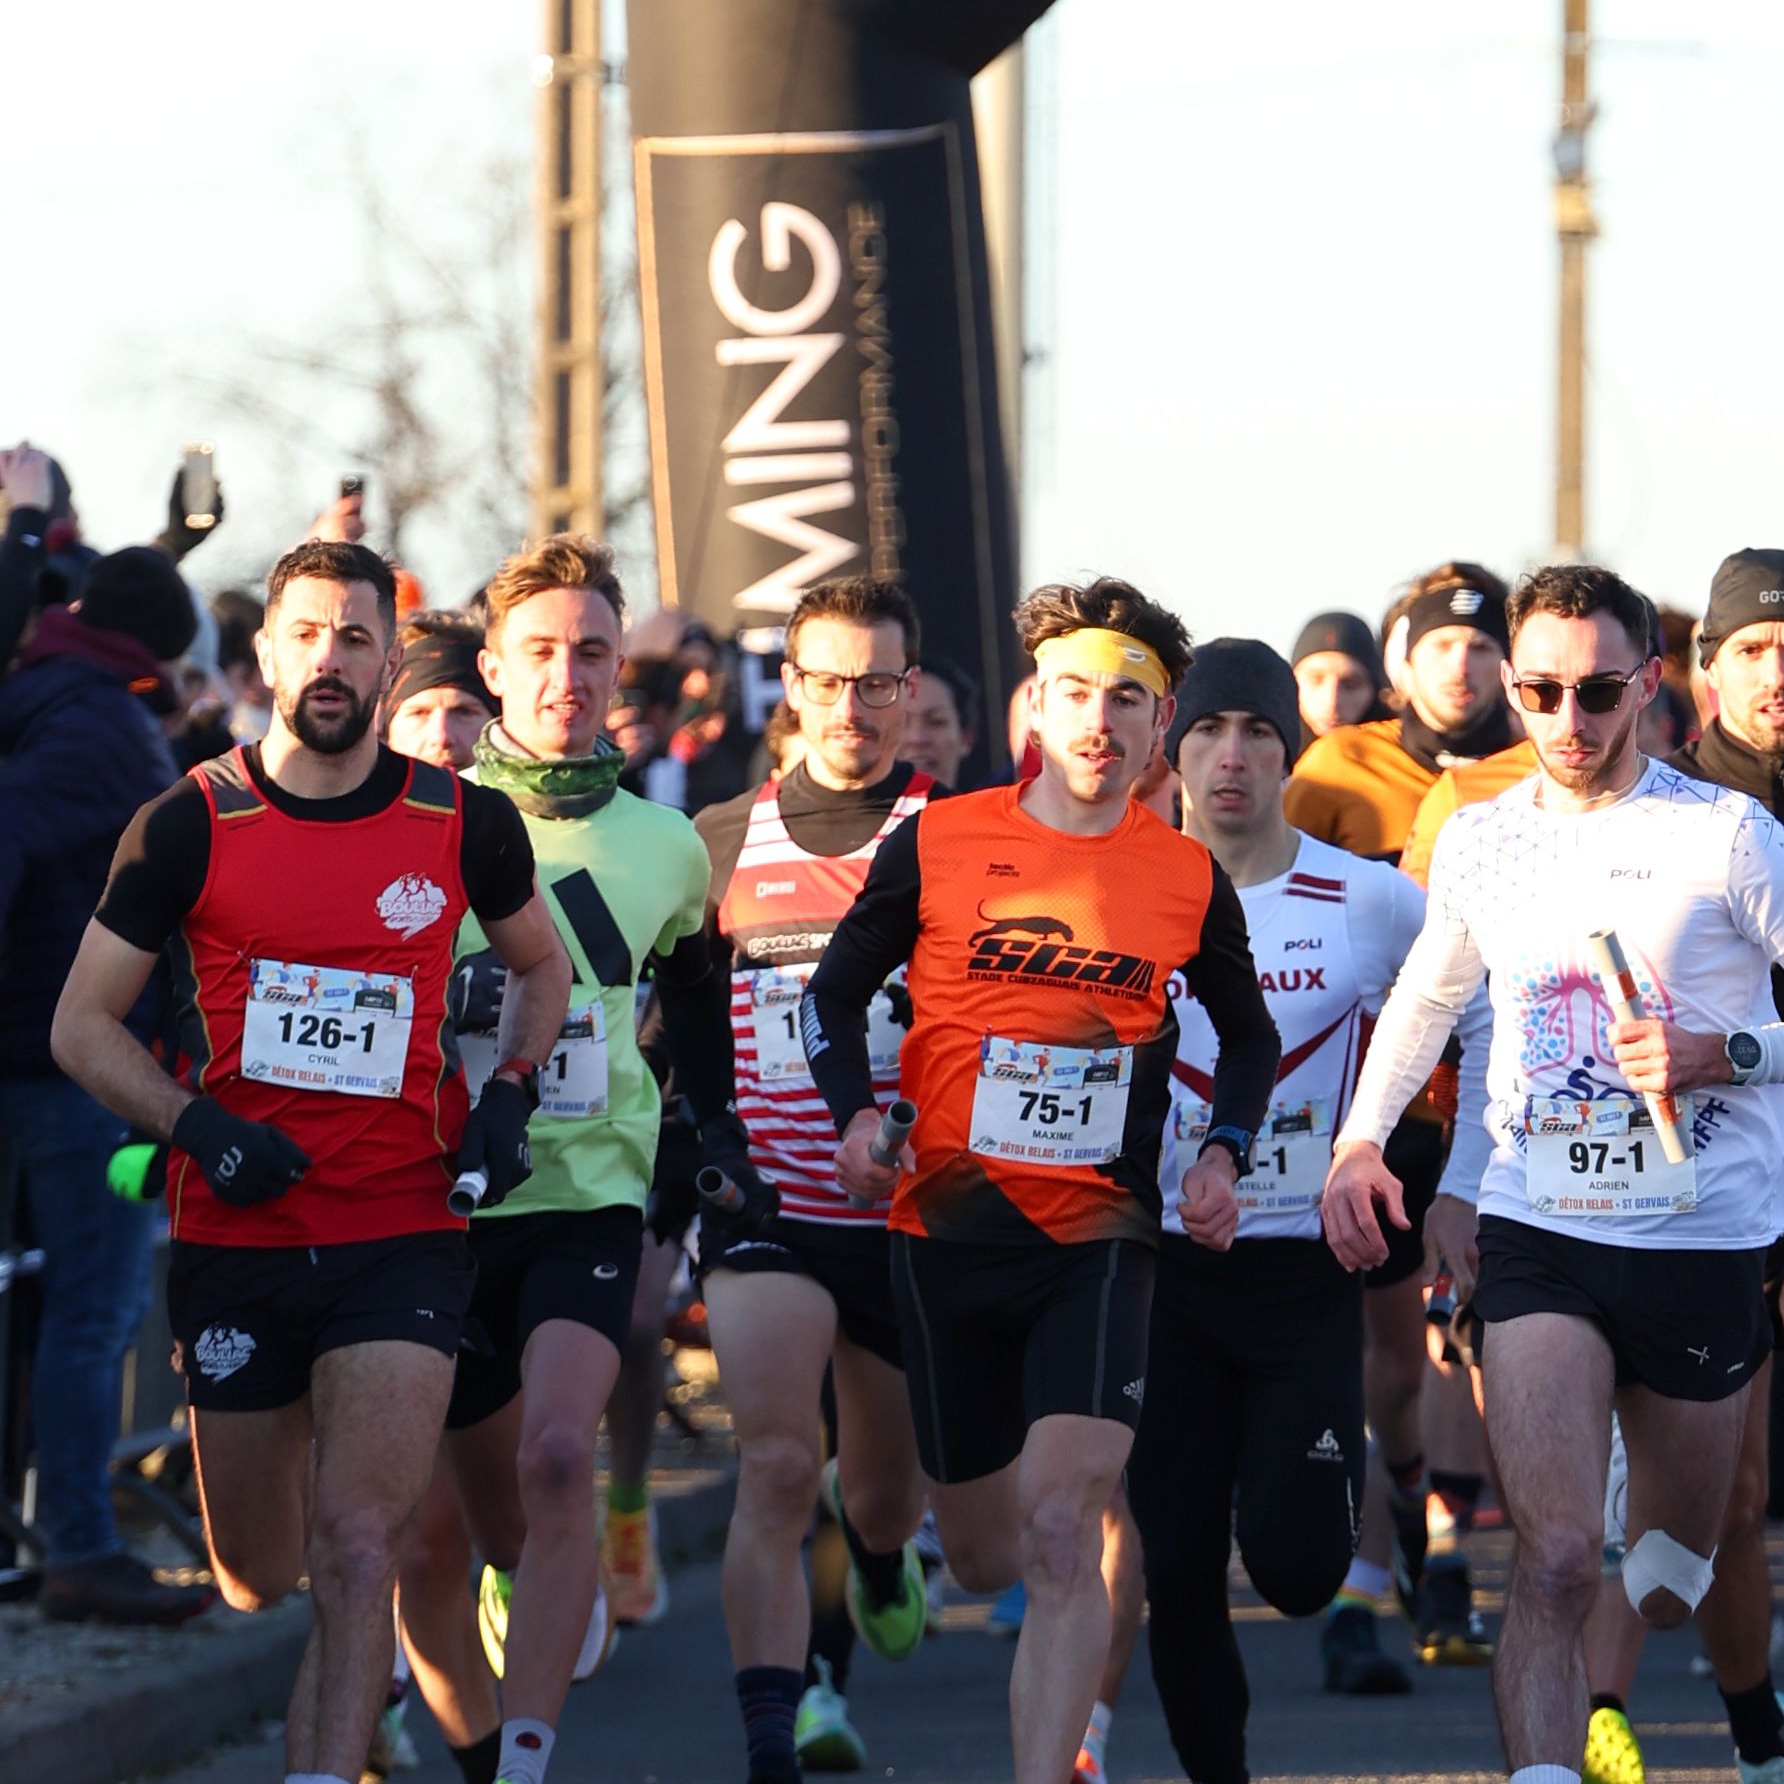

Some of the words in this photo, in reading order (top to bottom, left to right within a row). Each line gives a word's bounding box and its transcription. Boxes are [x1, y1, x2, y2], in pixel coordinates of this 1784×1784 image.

[1610, 869, 1651, 879] POLI
[1284, 938, 1323, 952] POLI
[967, 971, 1003, 982] STADE
[278, 1012, 375, 1053] 126-1
[308, 1054, 339, 1066] CYRIL
[298, 1068, 326, 1084] RELAIS
[334, 1075, 343, 1085] ST
[345, 1076, 378, 1089] GERVAIS
[1019, 1090, 1092, 1126] 75-1
[1032, 1129, 1074, 1141] MAXIME
[1000, 1141, 1025, 1155] DÉTOX
[1028, 1145, 1056, 1158] RELAIS
[1063, 1149, 1072, 1159] ST
[1257, 1146, 1286, 1175] -1
[1569, 1141, 1644, 1174] 97-1
[1589, 1181, 1629, 1191] ADRIEN
[1558, 1197, 1584, 1210] DÉTOX
[1586, 1198, 1613, 1210] RELAIS
[1622, 1197, 1633, 1209] ST
[1635, 1196, 1670, 1209] GERVAIS
